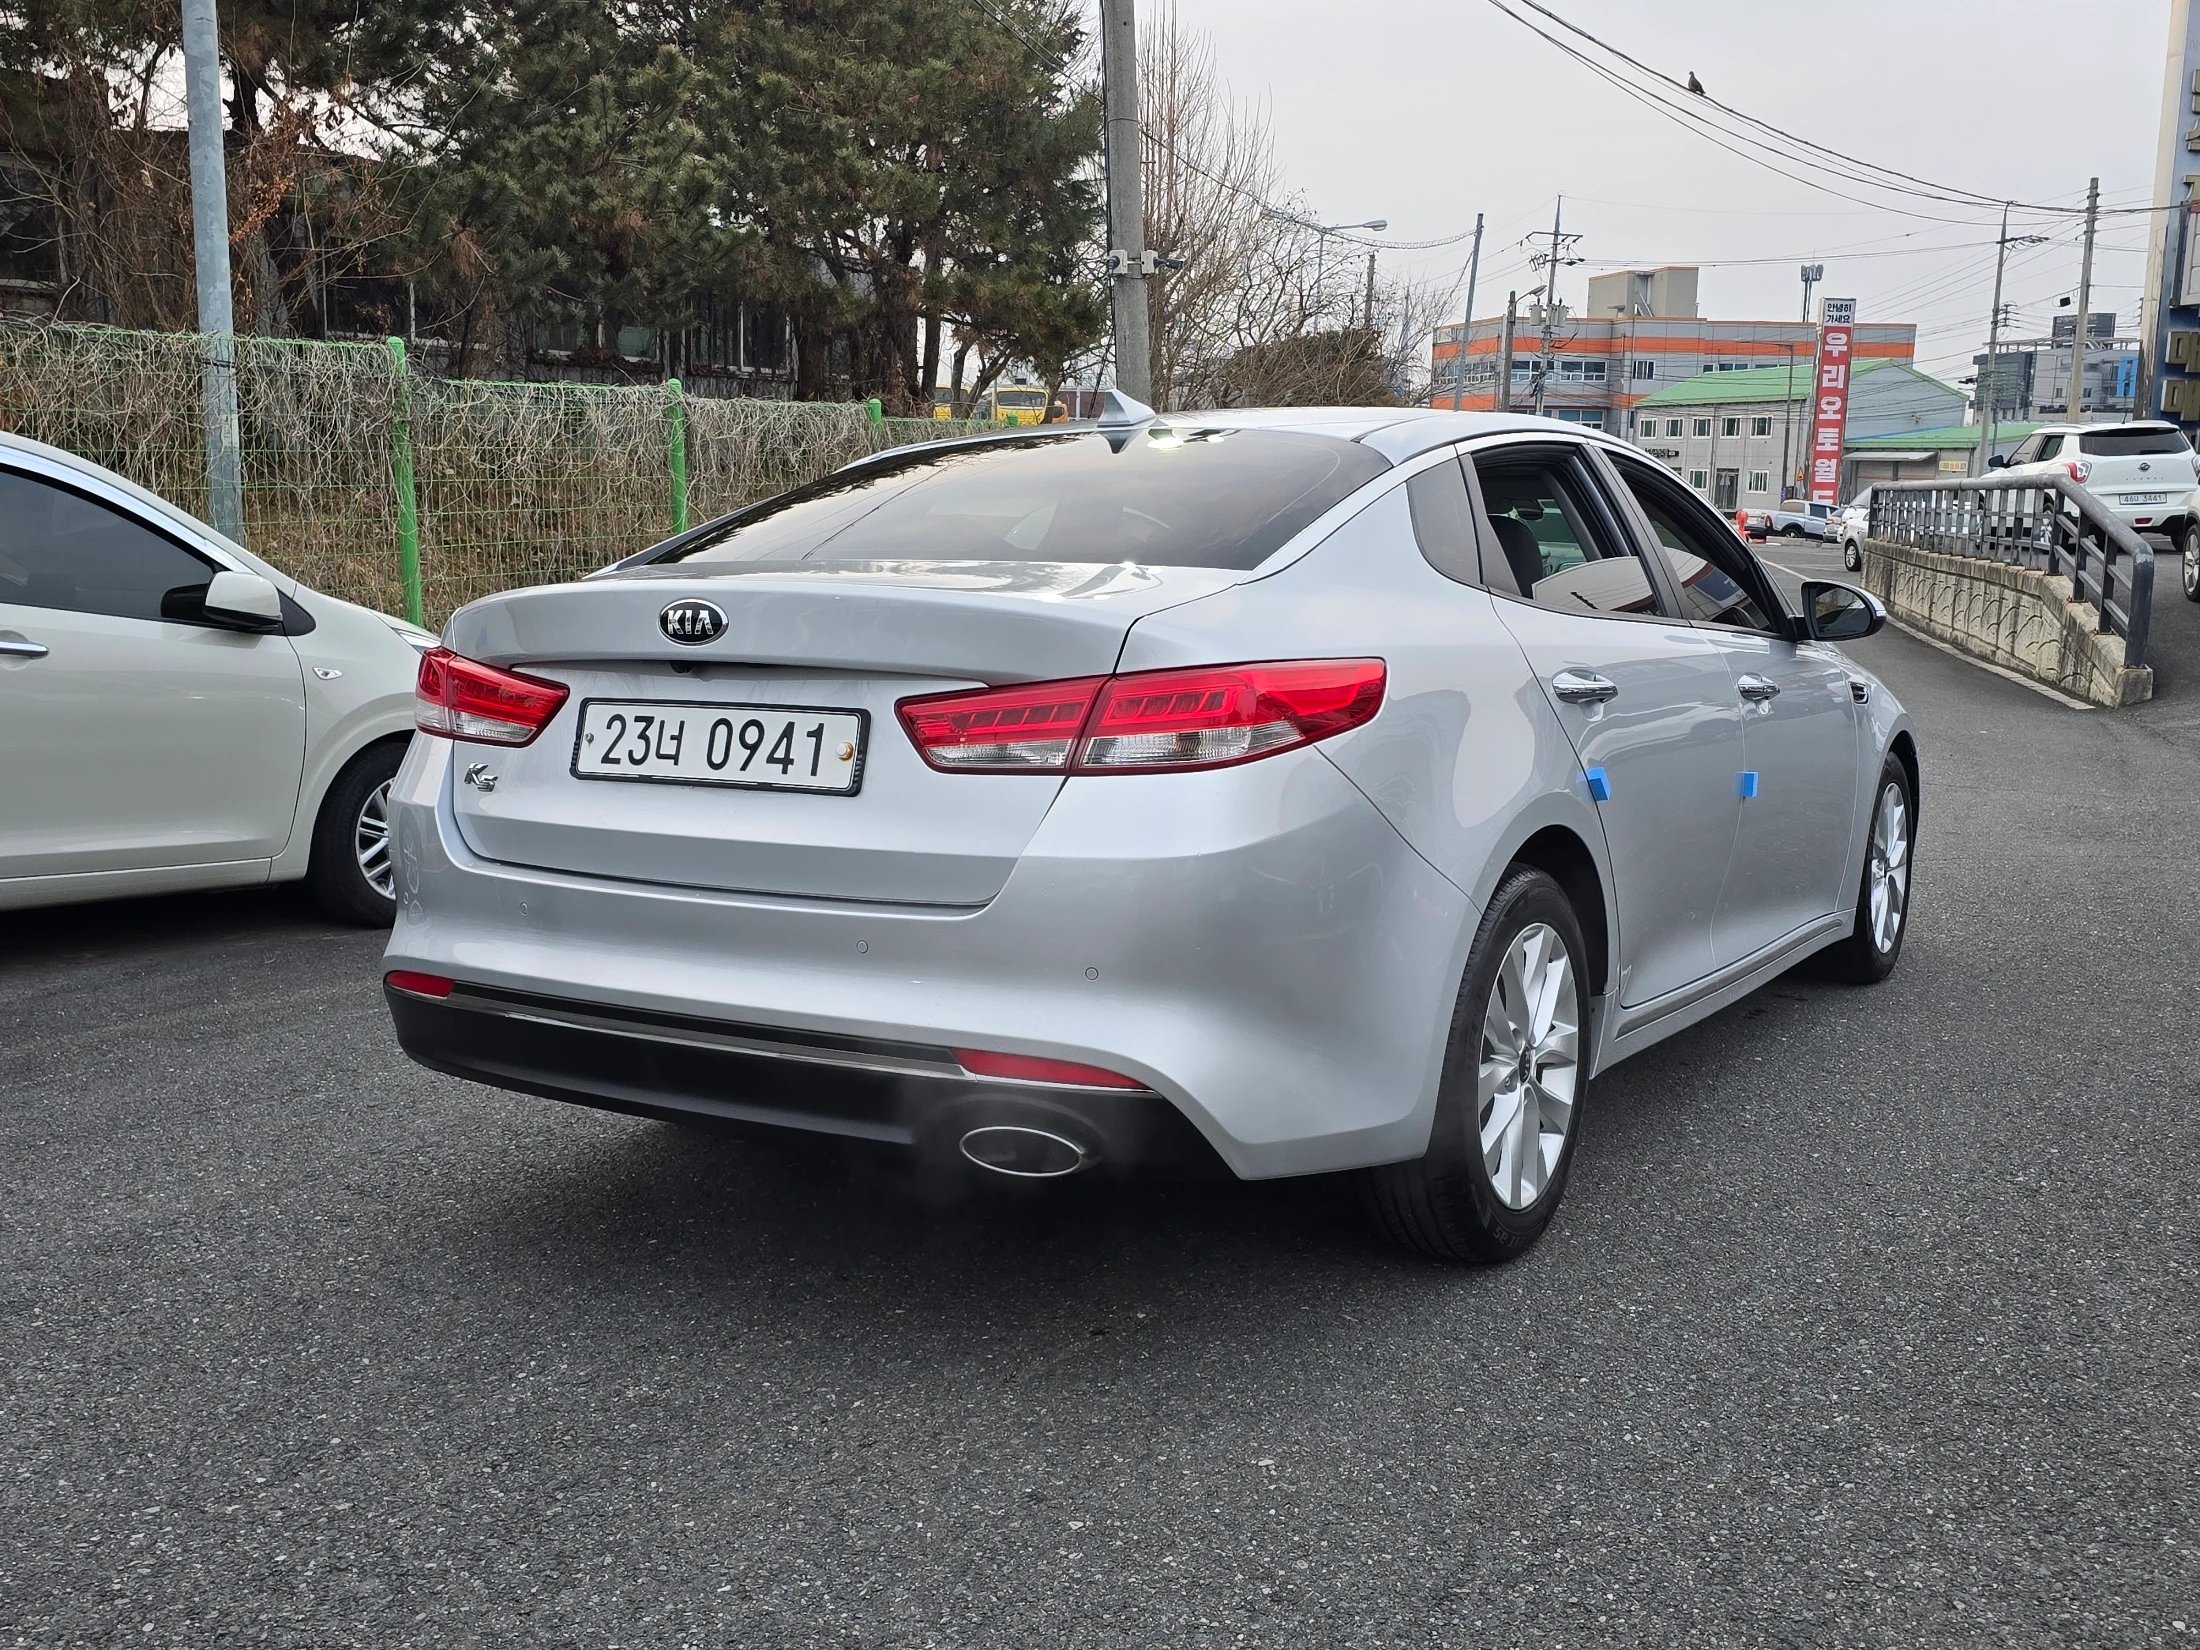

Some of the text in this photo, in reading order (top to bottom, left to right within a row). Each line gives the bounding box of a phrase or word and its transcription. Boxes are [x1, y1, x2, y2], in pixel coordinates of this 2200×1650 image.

[1826, 314, 1851, 324] 가세요
[1827, 303, 1852, 313] 안녕히
[667, 609, 715, 635] KIA
[601, 713, 826, 777] 23너 0941
[464, 761, 499, 793] K5
